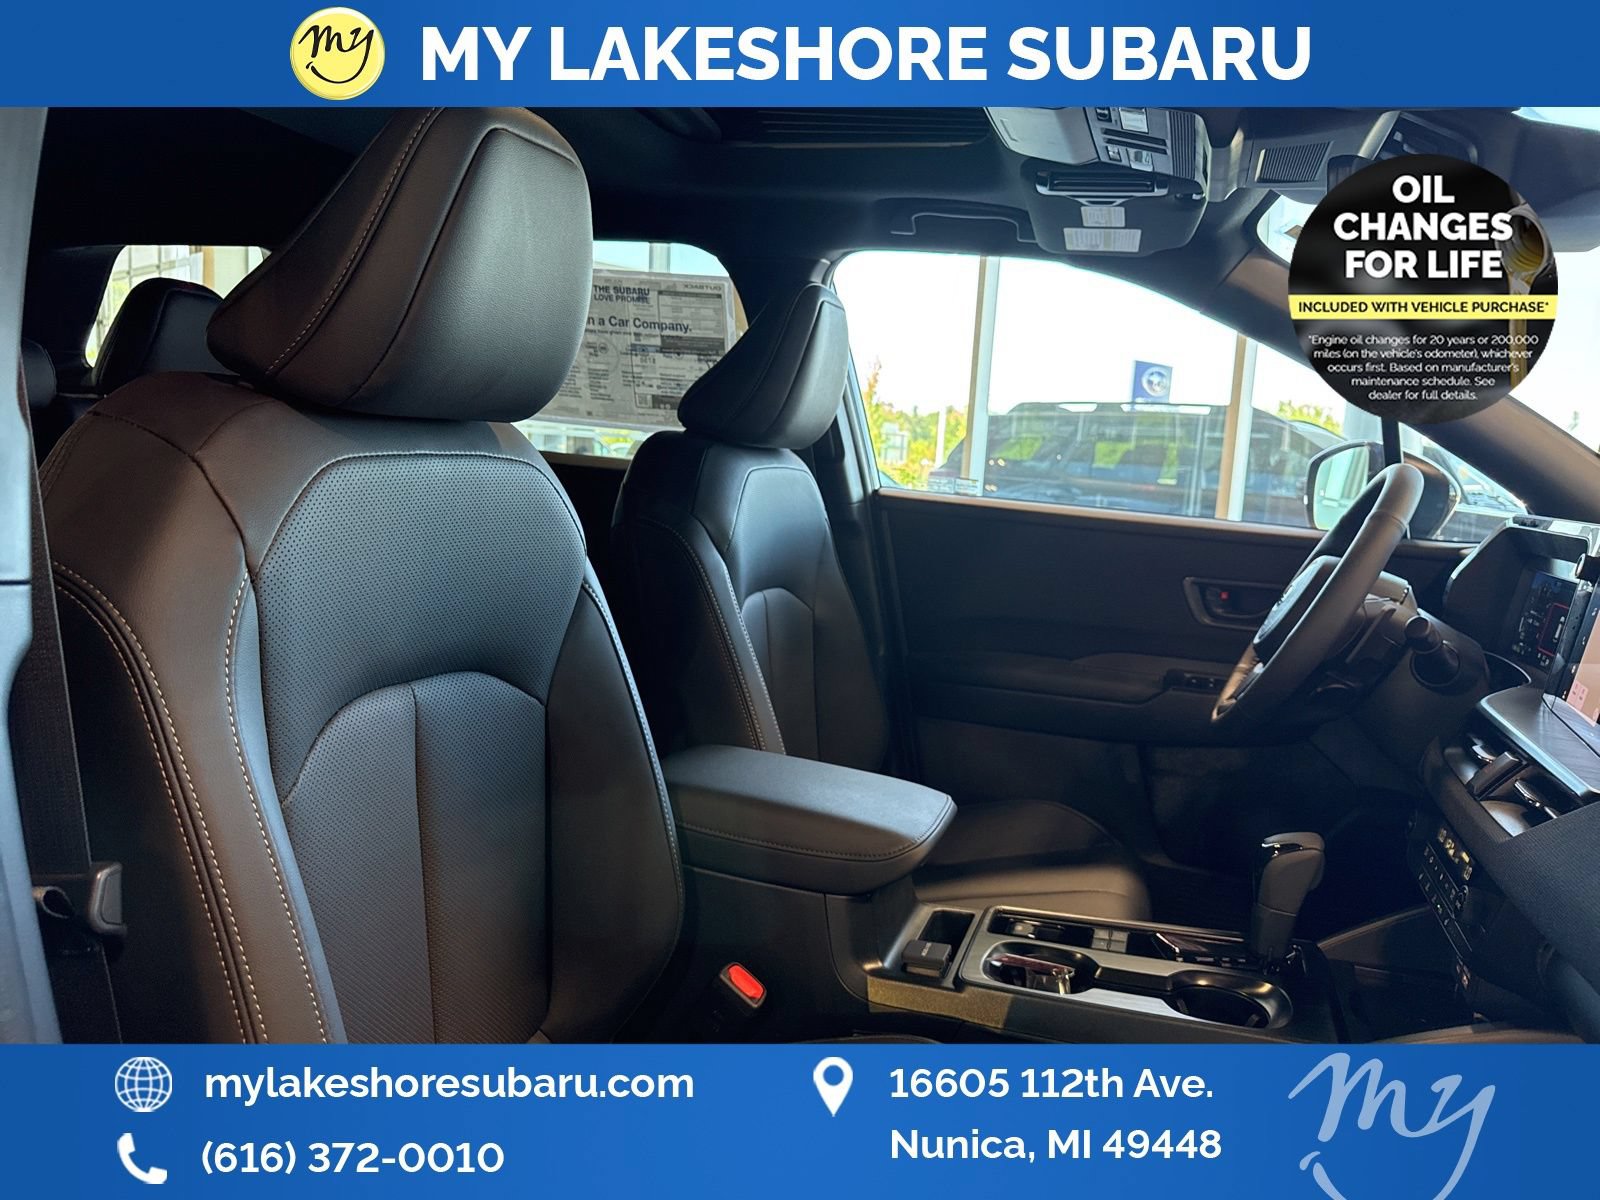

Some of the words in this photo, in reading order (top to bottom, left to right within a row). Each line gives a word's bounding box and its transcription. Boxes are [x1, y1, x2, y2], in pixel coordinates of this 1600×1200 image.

[593, 284, 610, 294] THE
[613, 285, 650, 297] SUBARU
[594, 294, 614, 302] LOVE
[598, 317, 605, 326] a
[608, 315, 630, 328] Car
[632, 317, 692, 334] Company.
